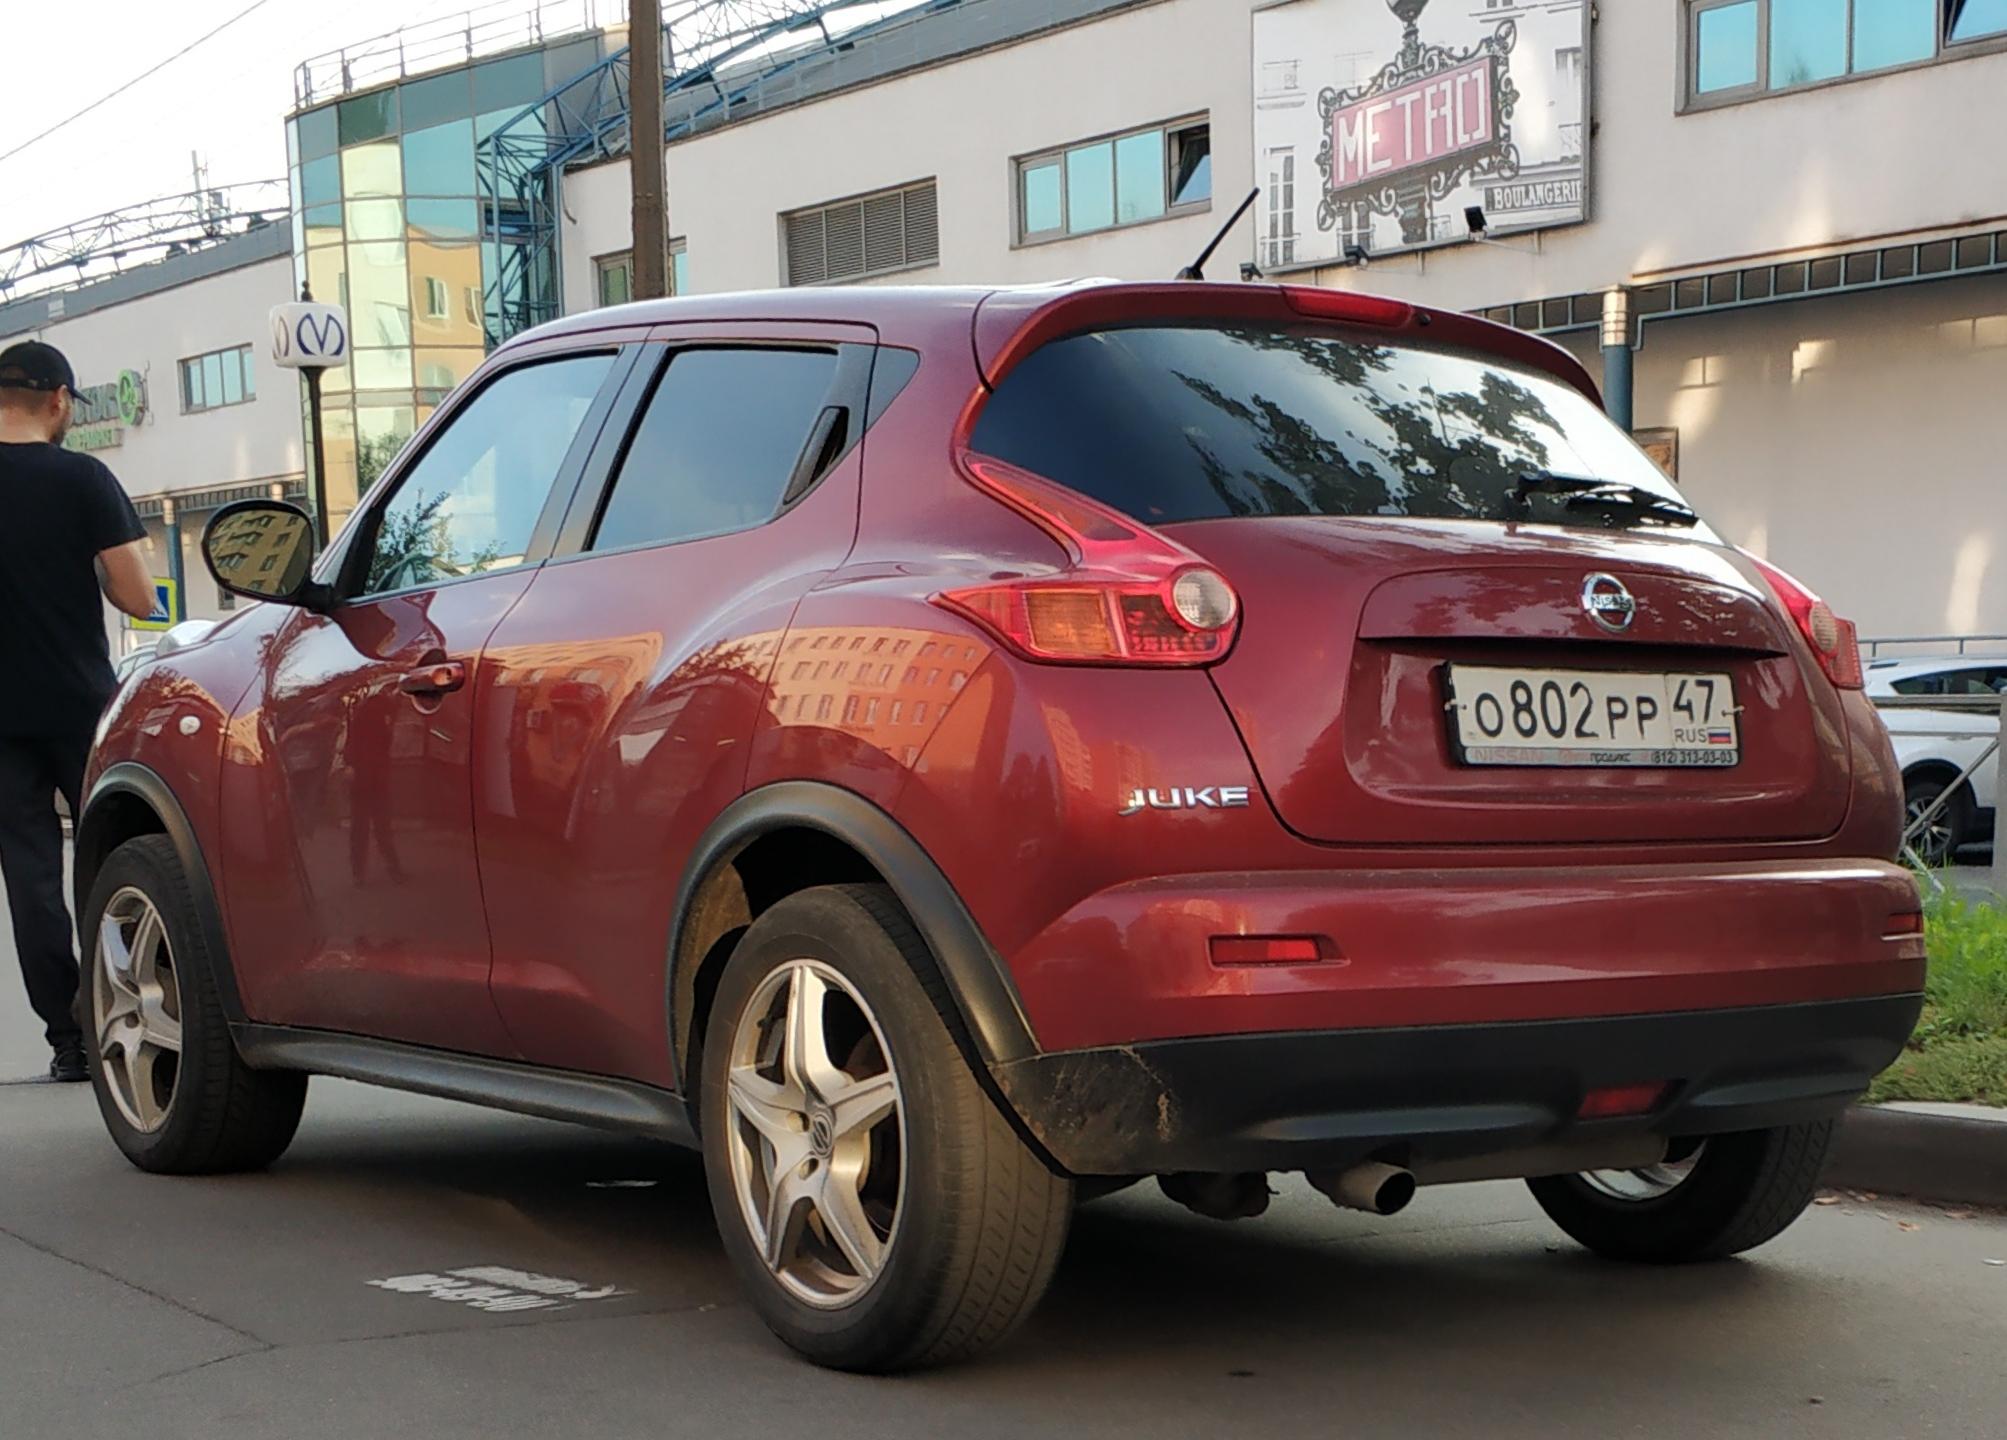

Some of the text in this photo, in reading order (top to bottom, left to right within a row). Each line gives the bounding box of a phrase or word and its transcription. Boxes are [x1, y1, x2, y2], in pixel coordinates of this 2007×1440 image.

[1338, 67, 1486, 182] METRO
[1673, 679, 1715, 725] 47
[1674, 727, 1706, 744] RUS
[1118, 786, 1249, 816] JUKE
